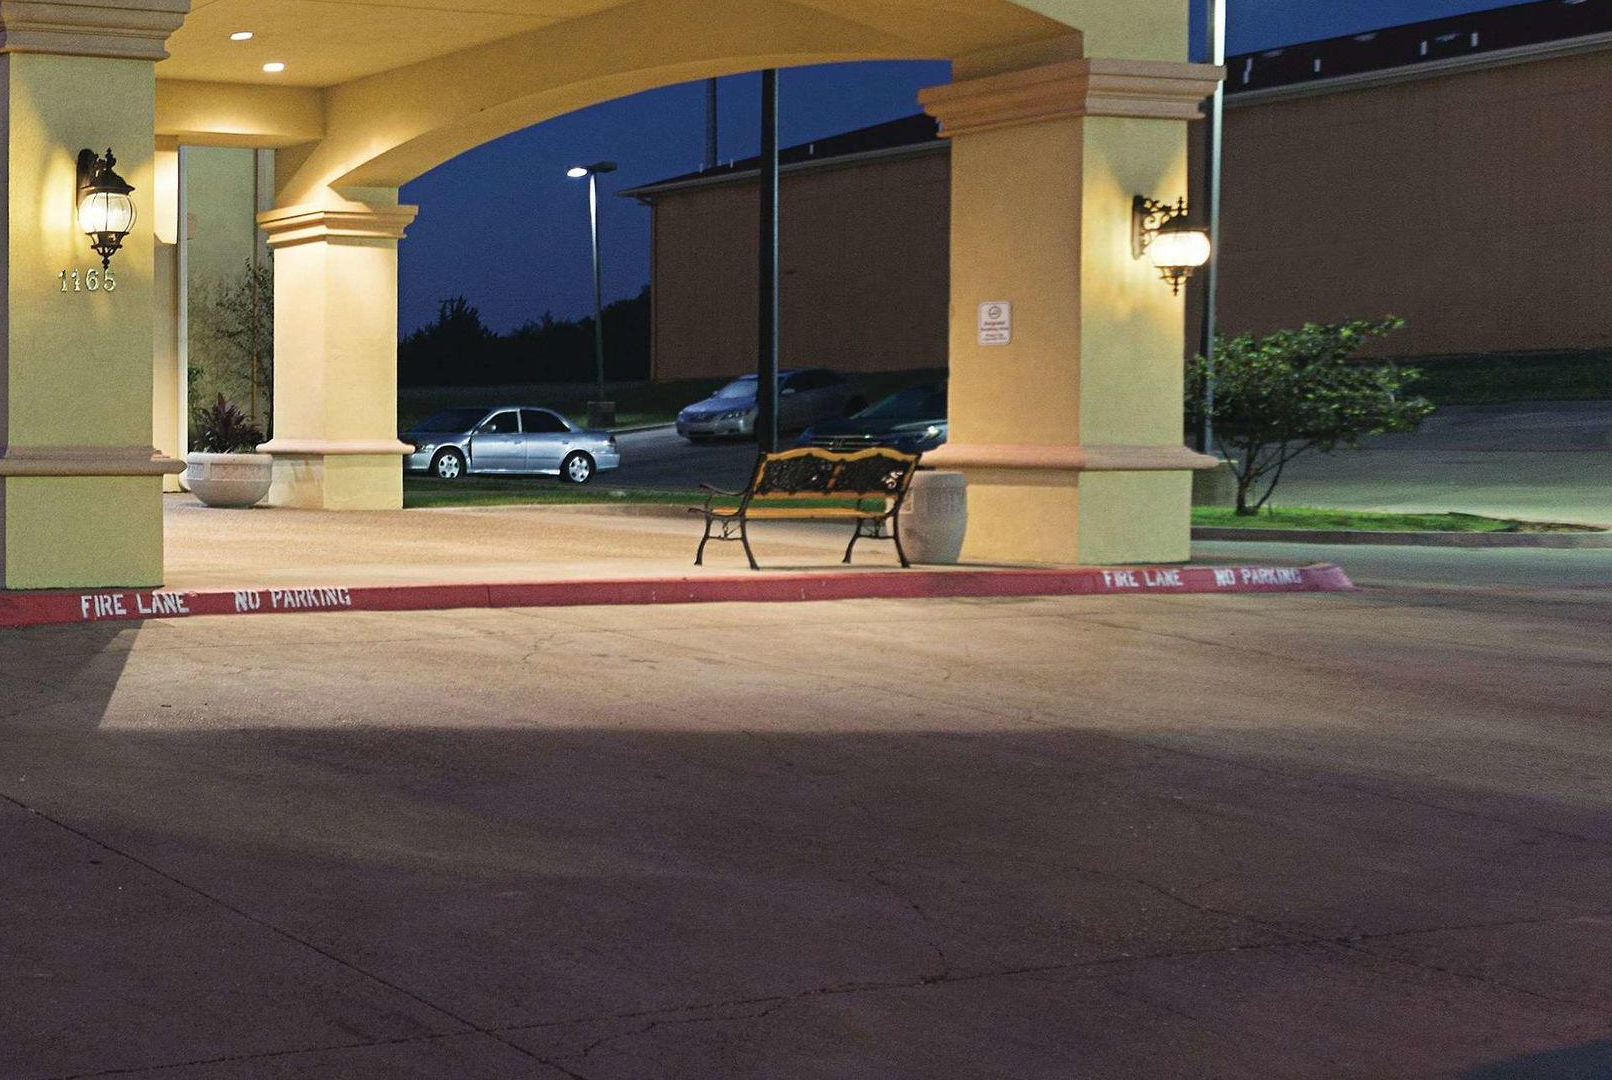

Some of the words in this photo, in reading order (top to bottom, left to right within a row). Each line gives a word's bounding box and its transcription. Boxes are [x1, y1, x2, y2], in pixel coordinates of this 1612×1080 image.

[57, 268, 117, 292] 1165
[1102, 570, 1140, 588] FIRE
[1143, 568, 1185, 587] LANE
[1213, 568, 1237, 587] NO
[1240, 567, 1302, 585] PARKING
[80, 594, 127, 618] FIRE
[135, 592, 190, 615] LANE
[234, 589, 261, 612] NO
[269, 587, 352, 610] PARKING
